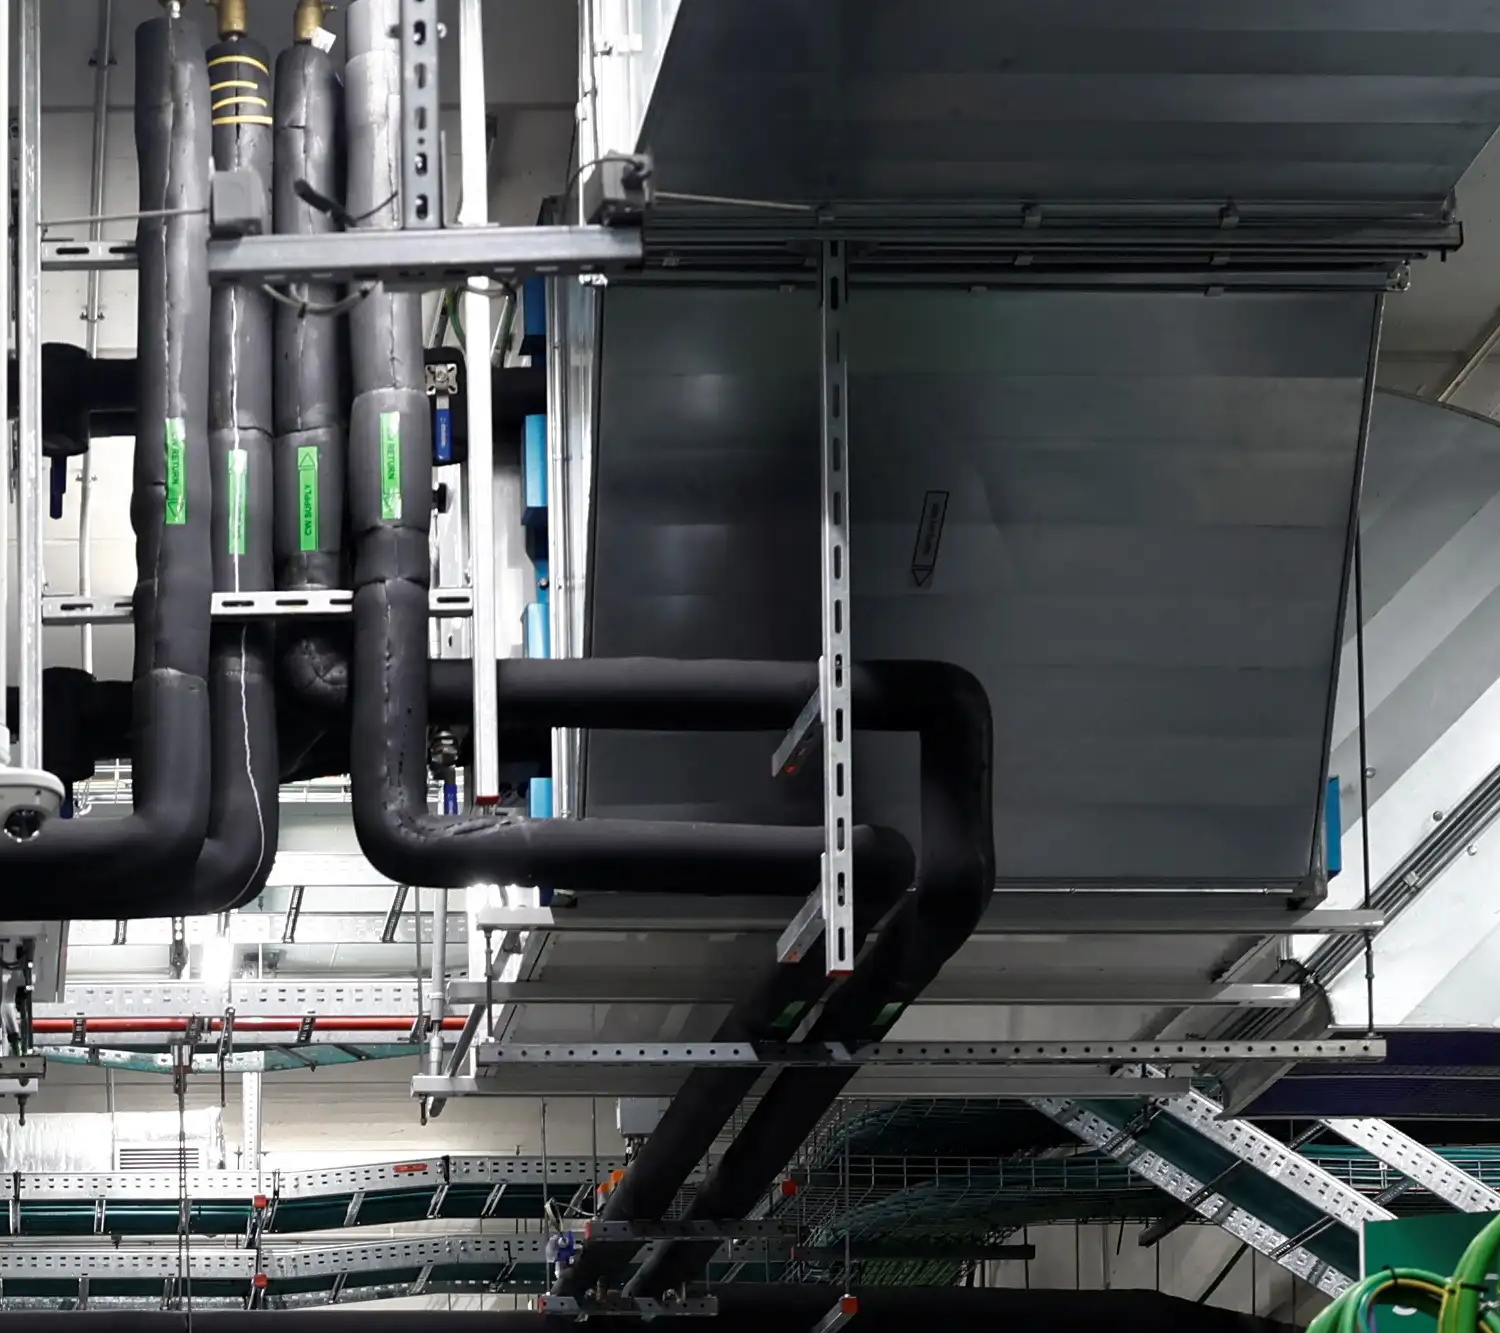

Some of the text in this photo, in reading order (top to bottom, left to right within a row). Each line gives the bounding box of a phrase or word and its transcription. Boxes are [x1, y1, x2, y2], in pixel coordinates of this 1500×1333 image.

[172, 449, 180, 486] RETURN
[387, 443, 396, 480] RETURN
[304, 484, 315, 535] CW SUPPLY
